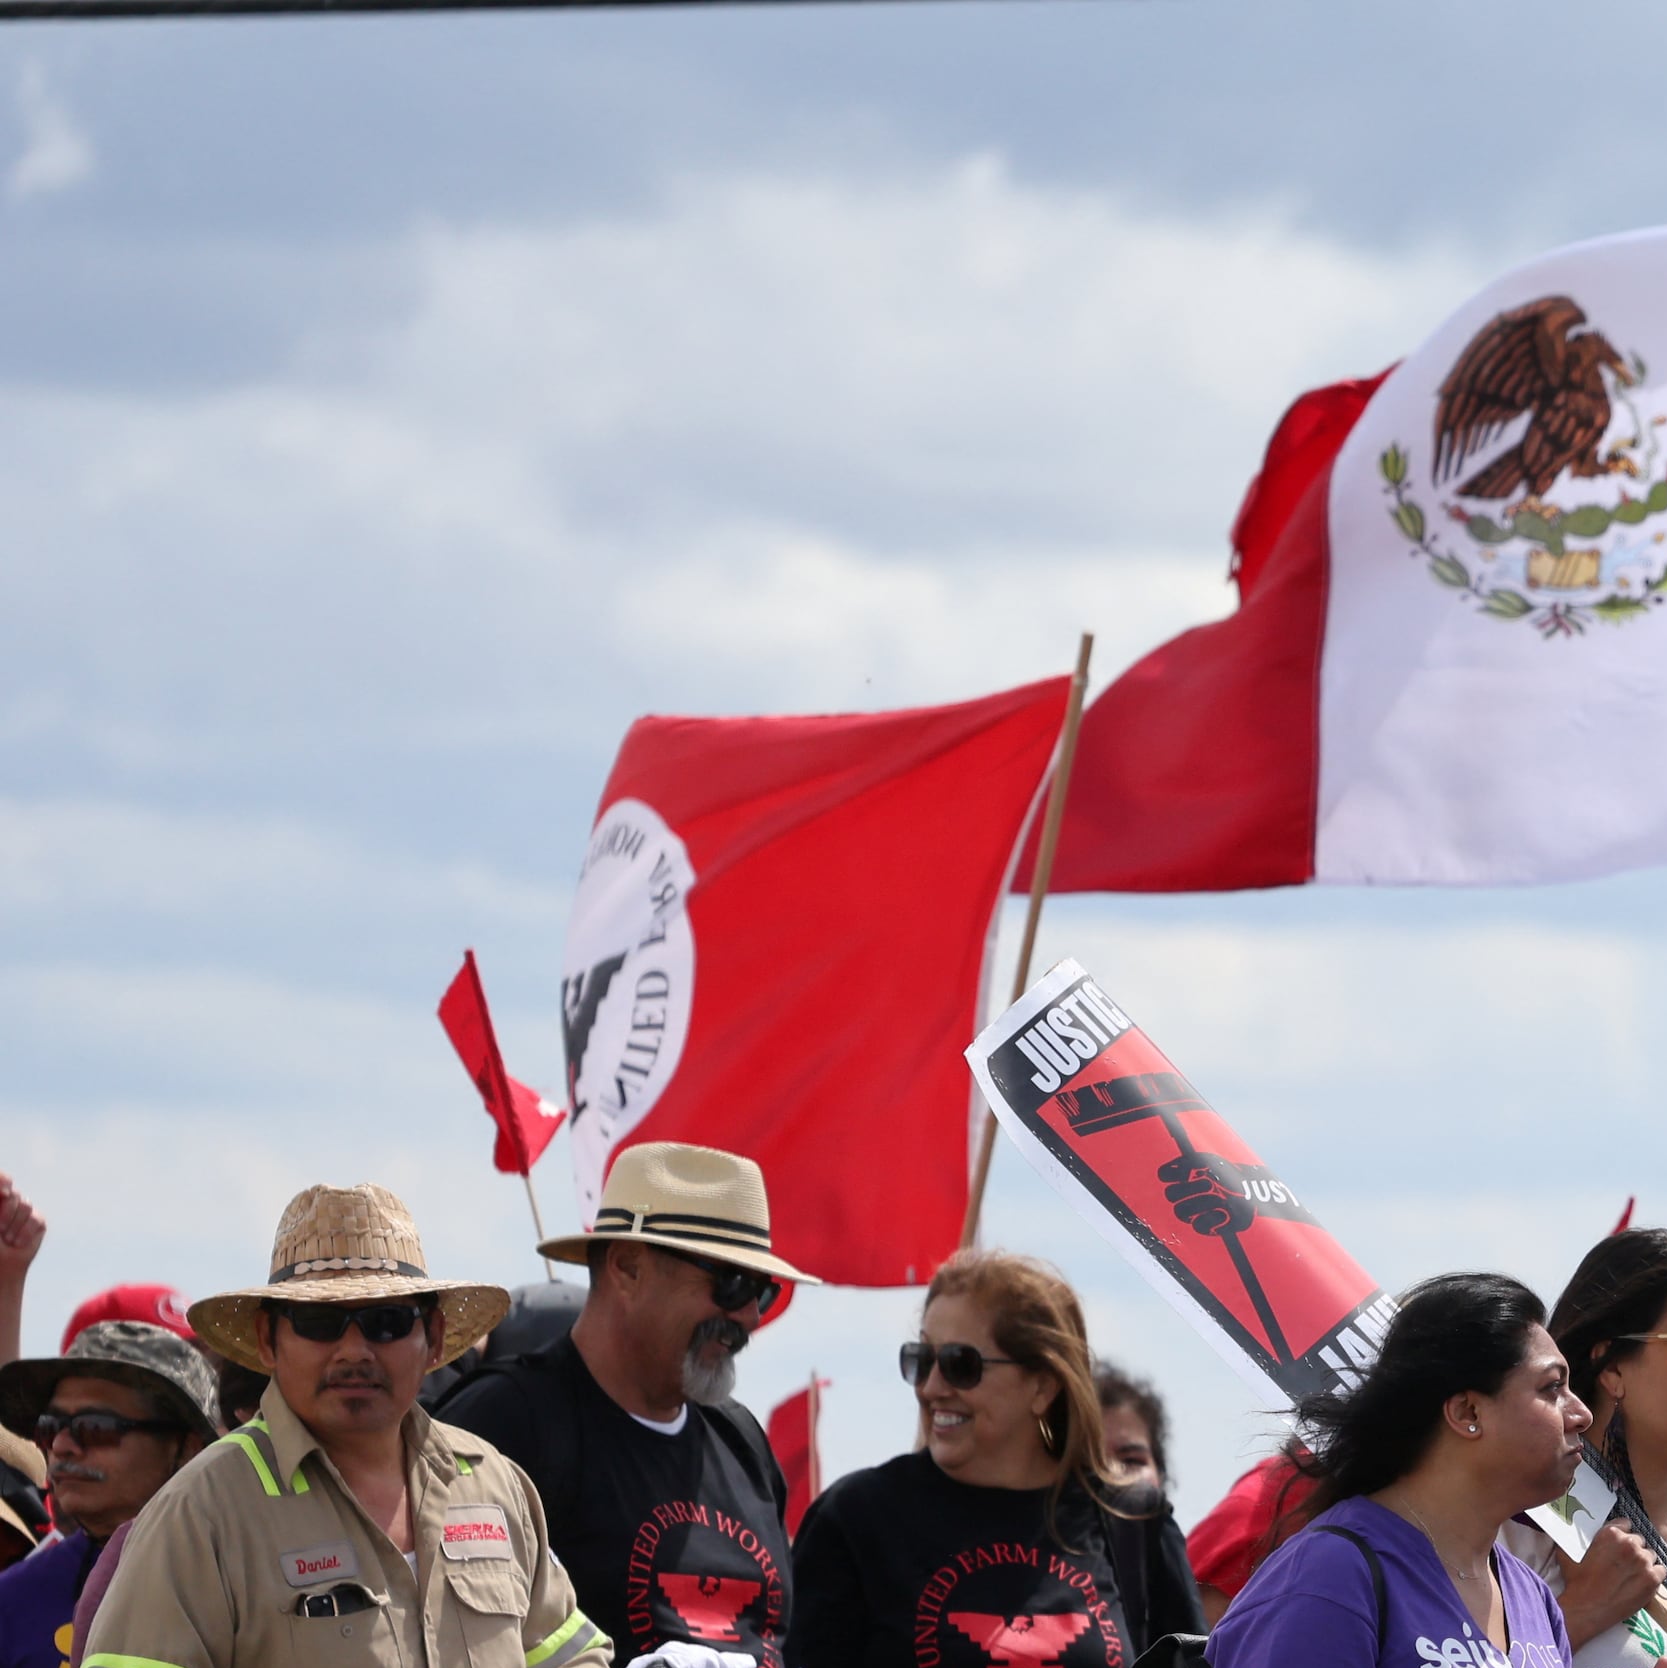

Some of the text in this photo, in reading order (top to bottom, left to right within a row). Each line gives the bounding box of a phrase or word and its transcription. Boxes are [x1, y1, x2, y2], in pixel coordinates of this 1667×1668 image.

[1014, 981, 1133, 1095] JUSTIC
[295, 1555, 341, 1575] Daniel
[627, 1521, 661, 1634] UNITED
[652, 1501, 710, 1530] FARM
[956, 1542, 1040, 1575] FARM
